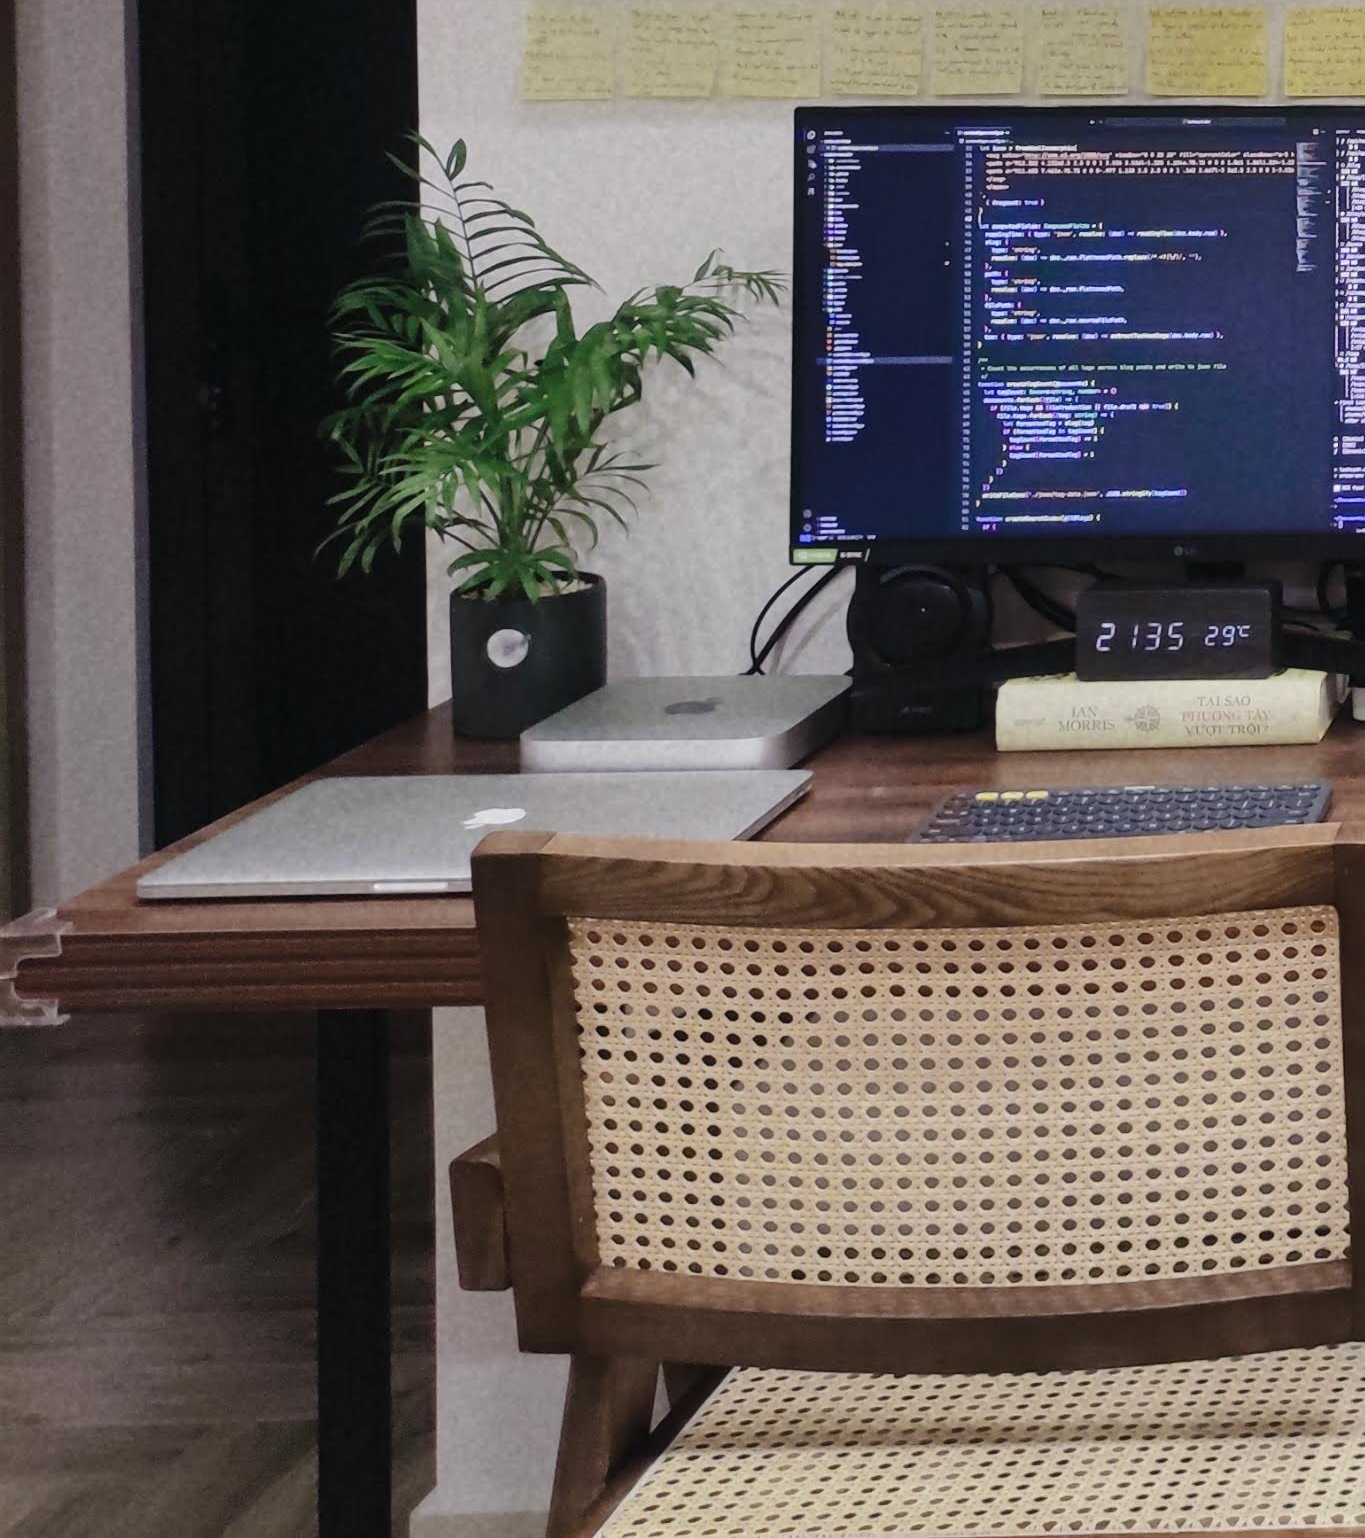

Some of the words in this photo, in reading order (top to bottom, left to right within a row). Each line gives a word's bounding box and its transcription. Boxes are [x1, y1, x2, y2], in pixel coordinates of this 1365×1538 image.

[1223, 695, 1252, 706] SAO
[1071, 706, 1100, 719] IAN
[1058, 718, 1116, 733] MORRIS
